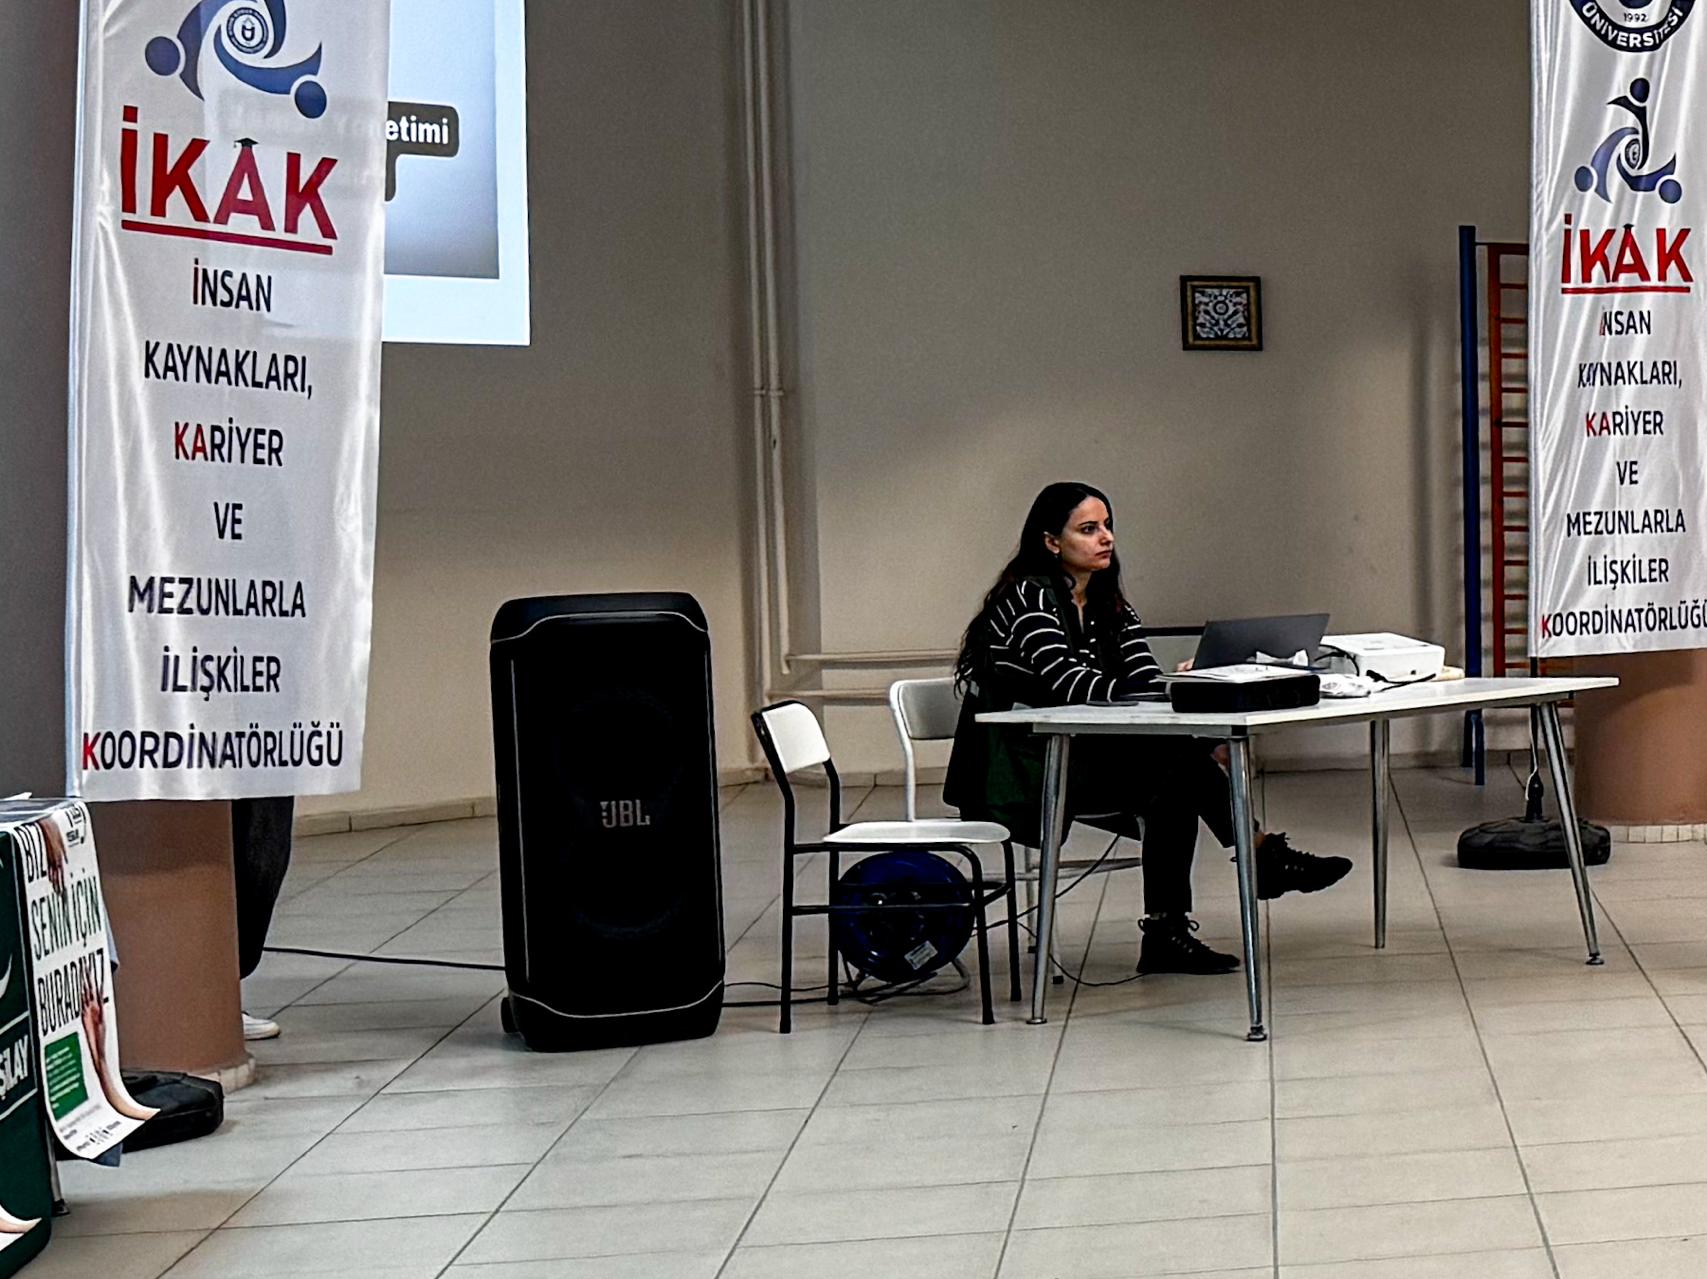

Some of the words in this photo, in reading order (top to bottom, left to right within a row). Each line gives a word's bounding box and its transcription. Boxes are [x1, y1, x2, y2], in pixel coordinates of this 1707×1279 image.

[1623, 13, 1647, 23] 1992
[385, 115, 449, 144] etimi
[121, 105, 338, 240] İKAK
[1561, 213, 1694, 284] İKAK
[193, 258, 272, 312] İNSAN
[1599, 306, 1652, 336] İNSAN
[144, 340, 312, 400] KAYNAKLARI,
[1585, 405, 1664, 437] KARİYER
[174, 417, 284, 466] KARİYER
[1616, 460, 1639, 485] VE
[214, 501, 243, 540] VE
[1567, 508, 1686, 538] MEZUNLARLA
[1587, 553, 1669, 590] İLİŞKİLER
[128, 575, 306, 618] MEZUNLARLA
[160, 645, 281, 701] İLİŞKİLER
[82, 721, 343, 770] KOORDİNATÖRLÜĞÜ
[600, 799, 650, 828] JBL
